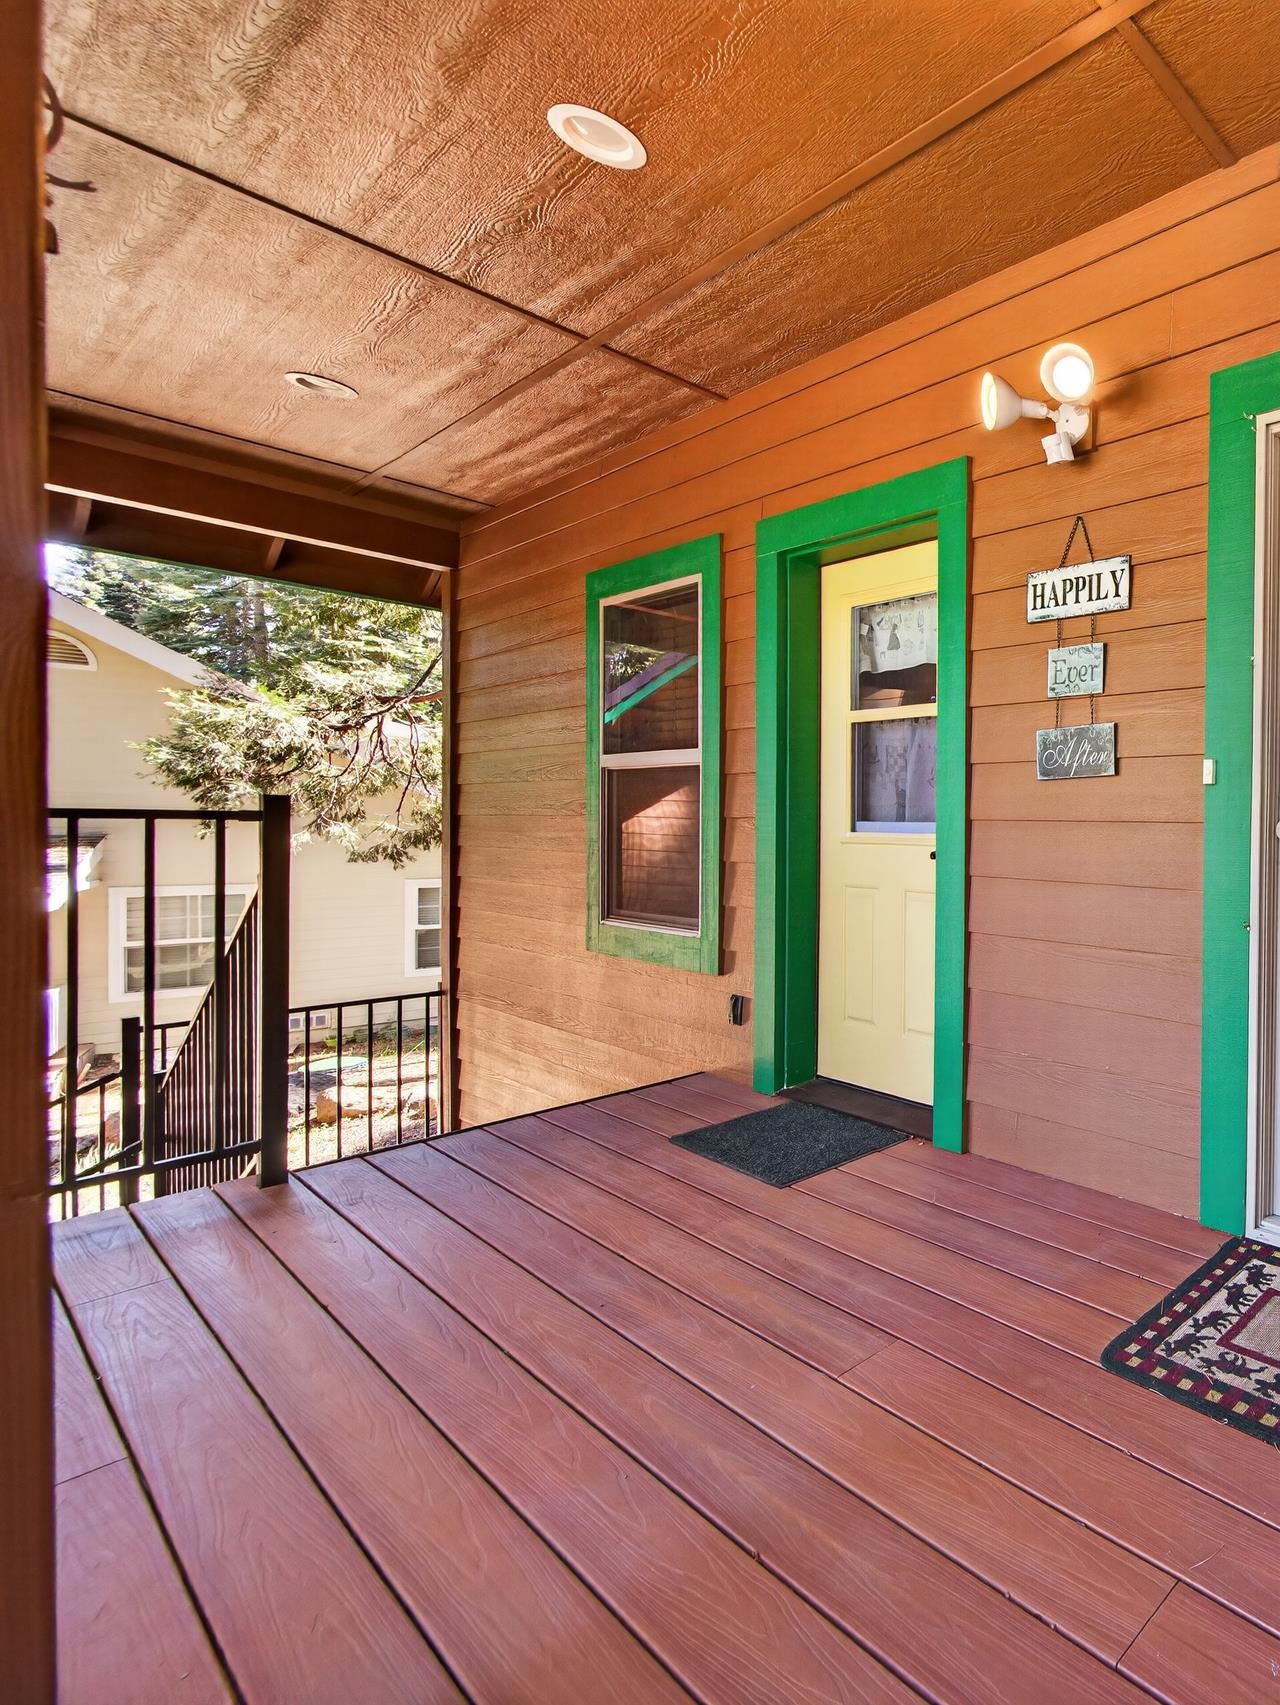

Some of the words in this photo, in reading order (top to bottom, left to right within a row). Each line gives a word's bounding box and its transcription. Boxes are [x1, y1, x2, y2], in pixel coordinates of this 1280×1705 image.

[1031, 568, 1126, 611] HAPPILY
[1052, 659, 1100, 685] Ever
[1043, 736, 1109, 777] After
